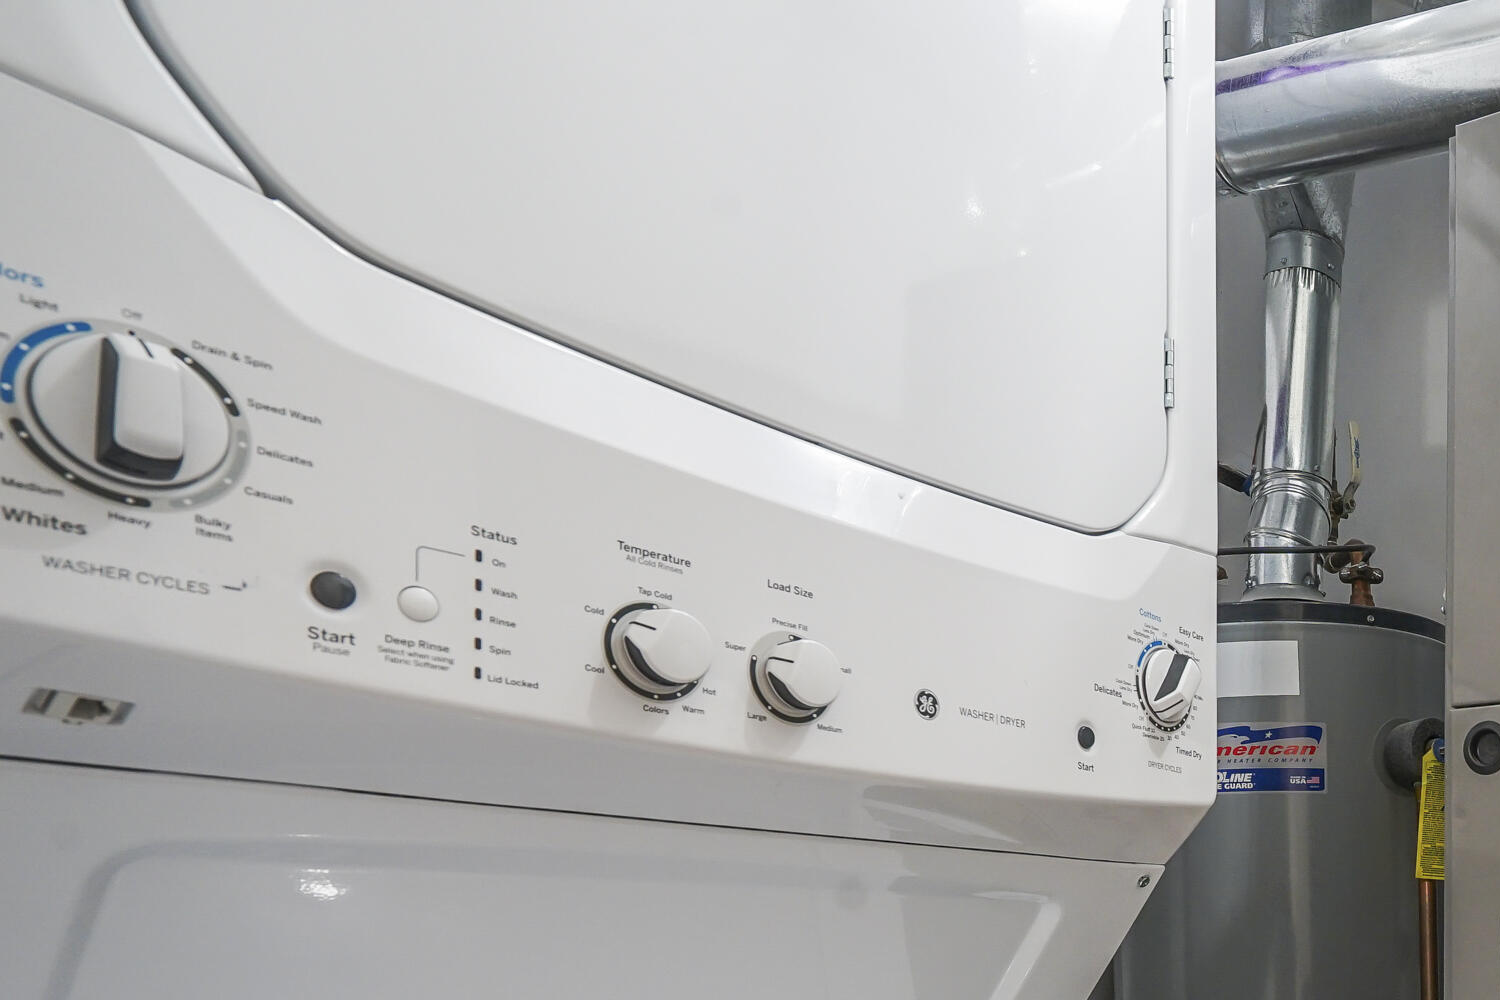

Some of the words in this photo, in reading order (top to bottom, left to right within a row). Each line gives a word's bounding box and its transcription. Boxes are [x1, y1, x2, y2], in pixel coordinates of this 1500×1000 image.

[0, 264, 44, 289] lors
[19, 293, 59, 312] Light
[121, 308, 144, 321] Off
[191, 340, 227, 358] Drain
[231, 351, 241, 362] &
[244, 354, 274, 371] Spin
[247, 398, 287, 418] Speed
[289, 408, 323, 425] Wash
[256, 446, 314, 468] Delicates
[1, 476, 65, 497] Medium
[244, 485, 294, 506] Casuals
[1, 504, 89, 537] Whites
[107, 510, 152, 530] Heavy
[194, 513, 232, 531] Bulky
[195, 527, 234, 543] Items
[470, 524, 518, 546] Status
[617, 540, 692, 568] Temperature
[491, 558, 507, 569] On
[638, 557, 657, 569] Cold
[657, 561, 684, 576] Rinses
[41, 554, 131, 582] WASHER
[136, 569, 211, 596] CYCLES
[491, 587, 518, 600] Wash
[638, 586, 652, 598] Tap
[653, 589, 673, 602] Cold
[767, 578, 791, 593] Load
[793, 585, 814, 600] Size
[584, 605, 605, 616] Cold
[1139, 608, 1161, 622] Cottons
[489, 616, 517, 628] Rinse
[771, 617, 797, 630] Precise
[798, 623, 809, 632] Fill
[307, 625, 357, 646] Start
[1179, 626, 1192, 637] Easy
[1192, 631, 1204, 641] Care
[312, 641, 351, 657] Pause
[384, 634, 415, 648] Deep
[418, 639, 450, 653] Rinse
[489, 645, 512, 657] Spin
[724, 641, 747, 652] Super
[584, 663, 605, 675] Cool
[487, 674, 503, 684] Lid
[504, 677, 539, 690] Locked
[702, 687, 717, 697] Hot
[1094, 683, 1122, 698] Delicates
[642, 703, 670, 716] Colors
[681, 705, 705, 716] Warm
[959, 706, 994, 721] WASHER
[1000, 715, 1025, 728] DRYER
[746, 712, 768, 723] Large
[817, 723, 843, 734] Medium
[1175, 746, 1192, 757] Timed
[1193, 750, 1202, 760] Dry
[1217, 745, 1317, 757] merican
[1077, 761, 1094, 773] Start
[1148, 761, 1164, 770] DRYER
[1165, 764, 1182, 774] CYCLES
[1217, 772, 1252, 783] OLINE
[1224, 782, 1253, 790] GUARD
